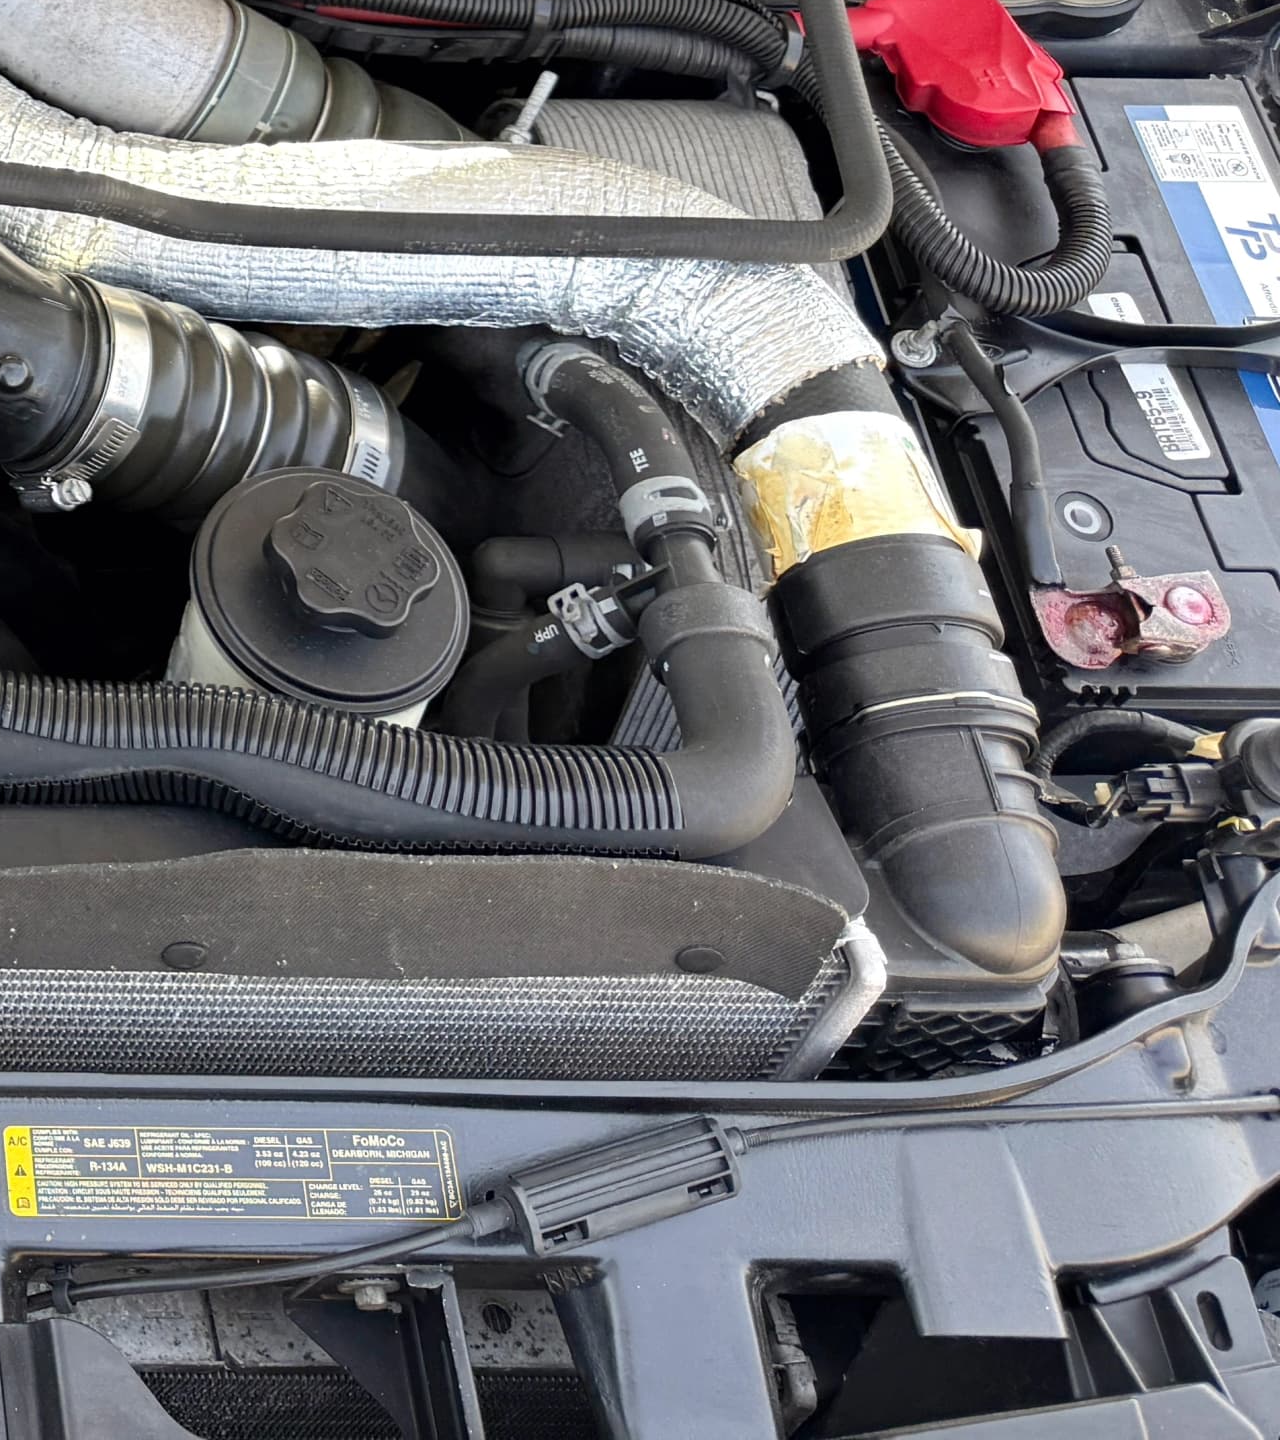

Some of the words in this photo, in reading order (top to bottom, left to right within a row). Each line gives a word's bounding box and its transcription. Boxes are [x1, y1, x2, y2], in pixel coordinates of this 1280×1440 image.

[629, 447, 650, 472] TEE
[534, 624, 559, 643] UPR
[8, 1136, 28, 1146] A/C
[83, 1138, 105, 1148] SAE
[107, 1138, 131, 1148] J639
[253, 1136, 281, 1145] DIESEL
[296, 1137, 313, 1145] GAS
[352, 1135, 405, 1147] FoMoCo
[332, 1149, 384, 1159] DEARBORN,
[386, 1150, 430, 1159] MICHIGAN
[89, 1161, 127, 1172] R-134A
[146, 1164, 233, 1174] WSH-M1C231-B
